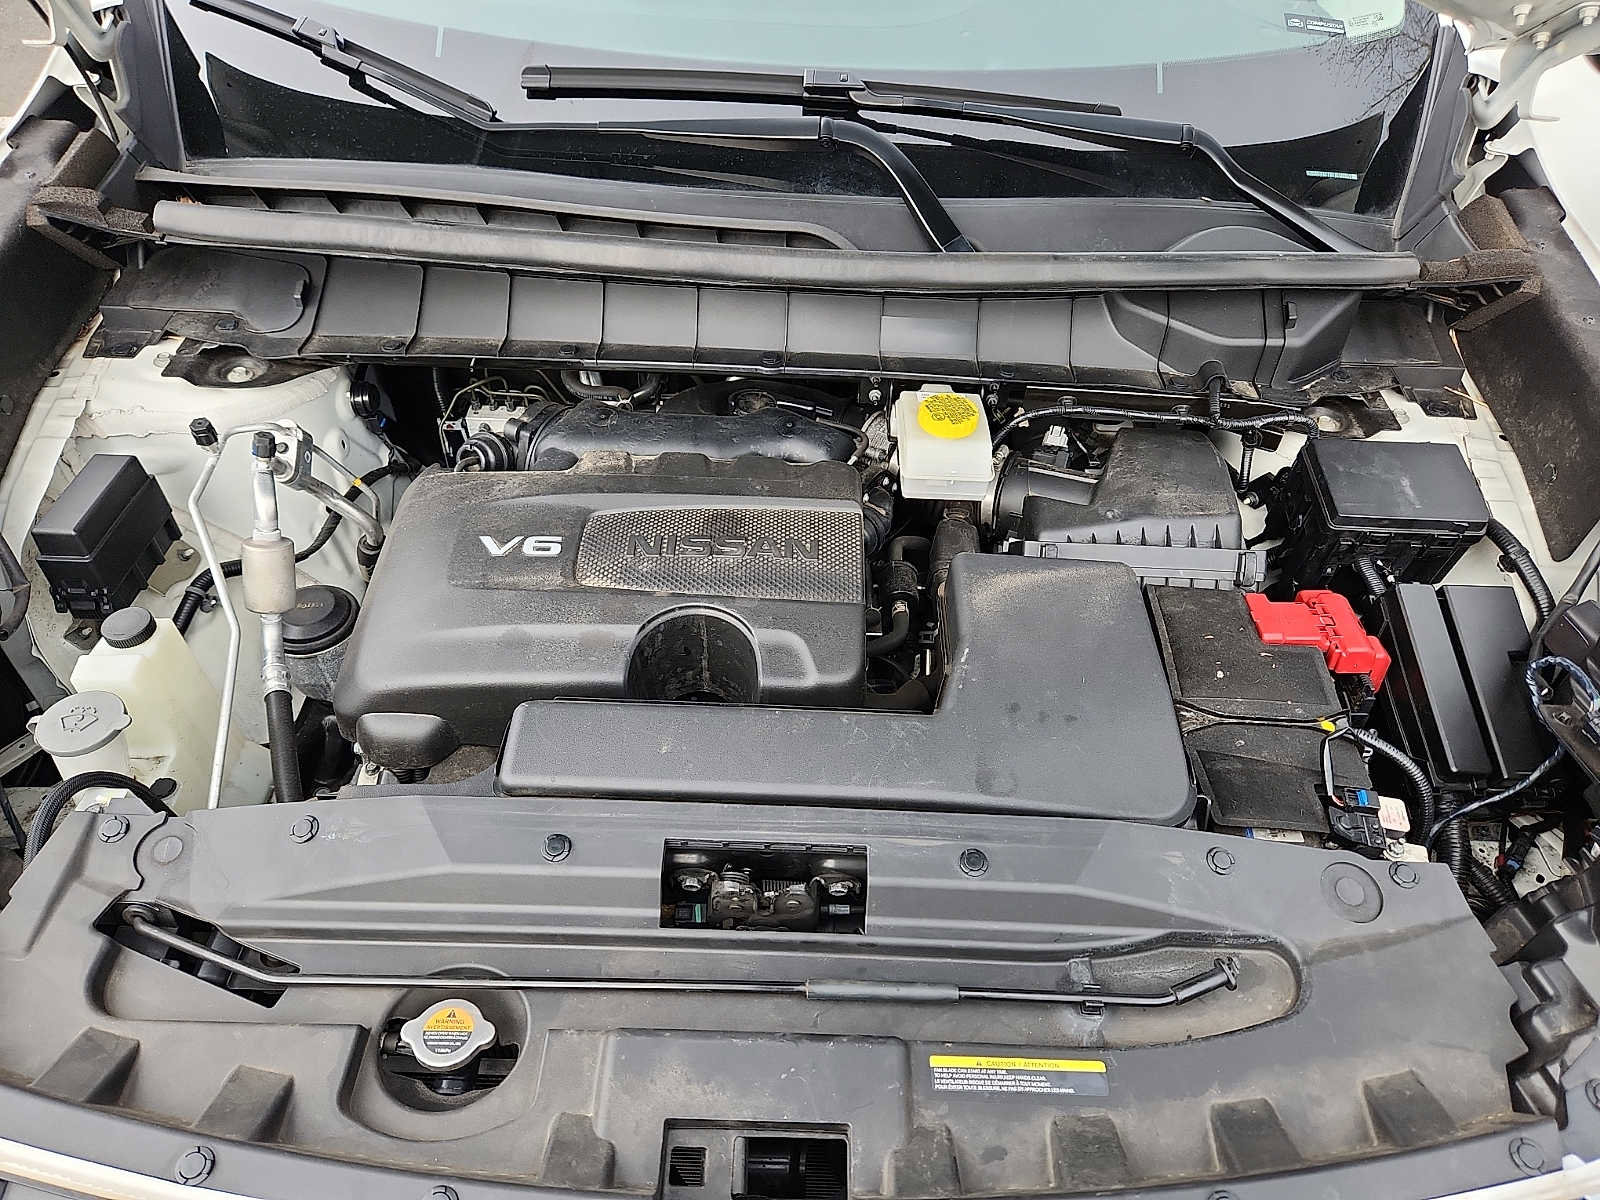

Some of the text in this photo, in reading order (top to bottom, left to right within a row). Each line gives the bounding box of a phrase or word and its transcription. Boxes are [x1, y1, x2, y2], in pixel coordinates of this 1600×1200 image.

[479, 535, 563, 557] V6
[626, 534, 819, 563] NISSAN
[1023, 1061, 1060, 1069] ATTENTION
